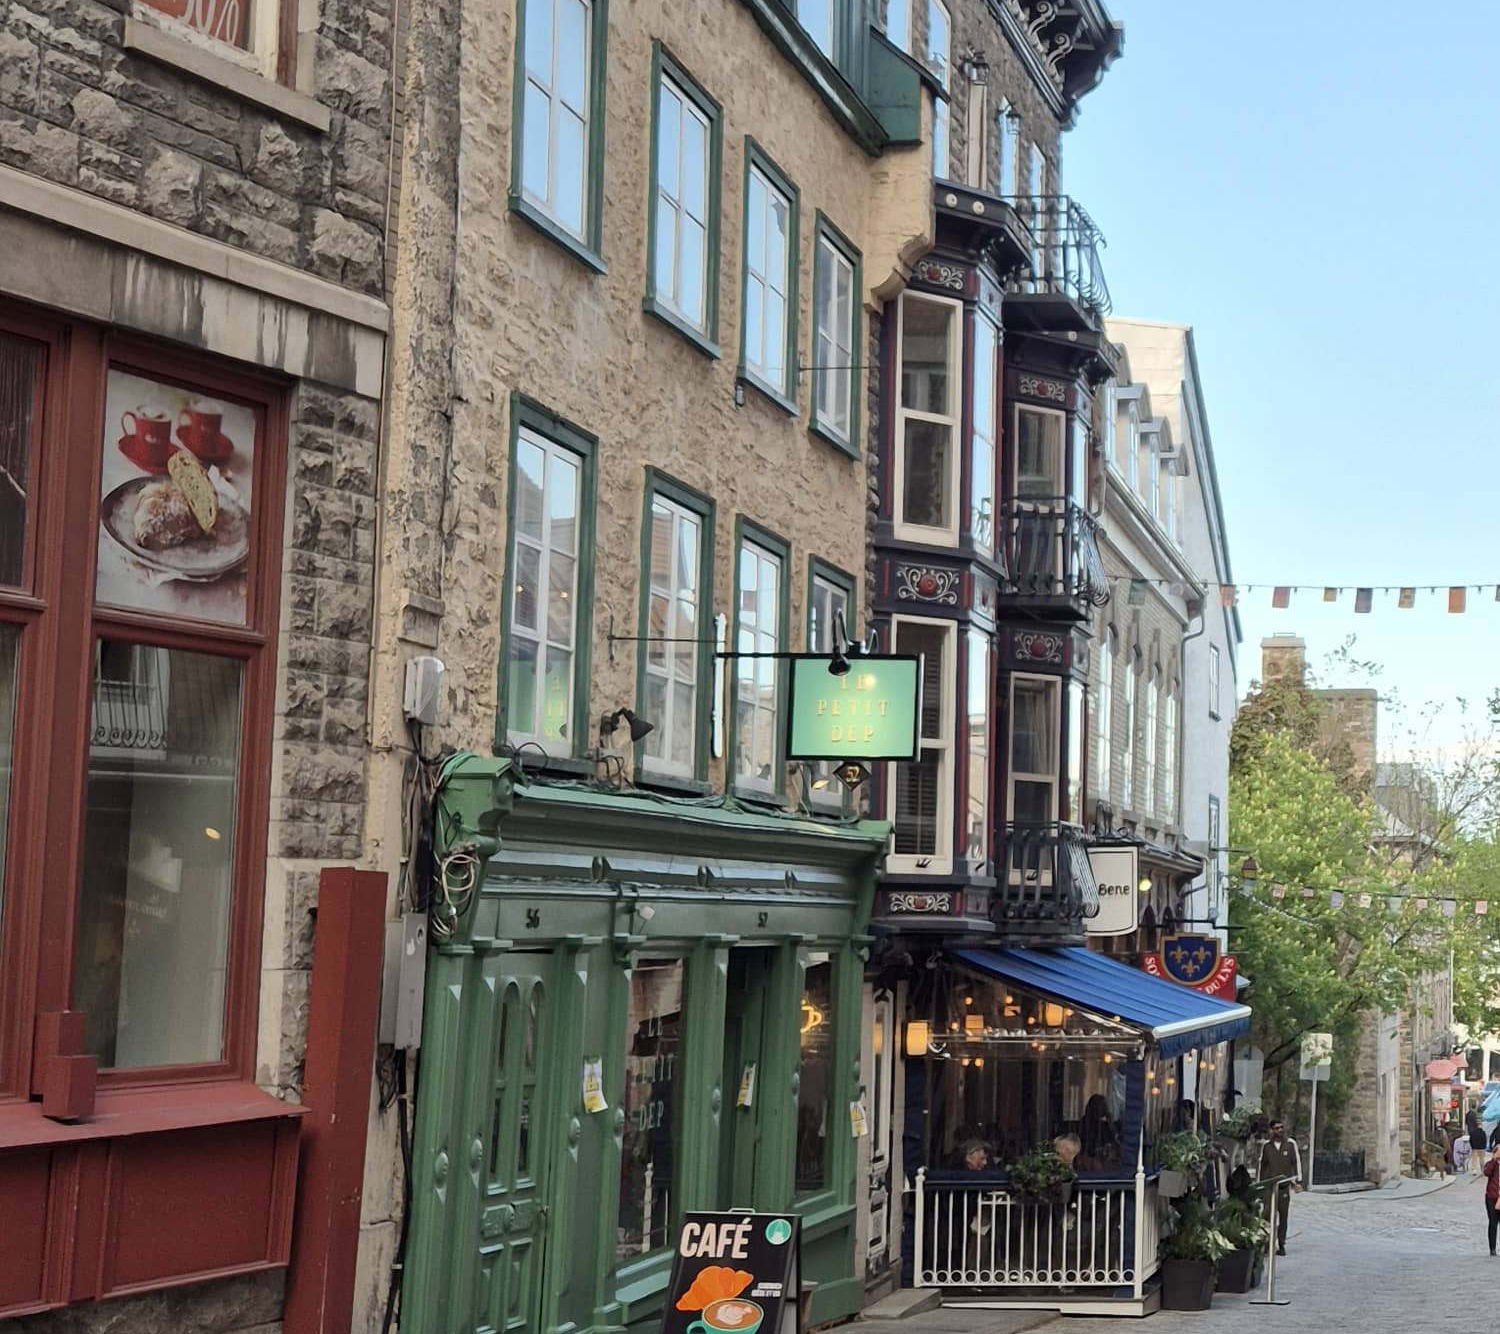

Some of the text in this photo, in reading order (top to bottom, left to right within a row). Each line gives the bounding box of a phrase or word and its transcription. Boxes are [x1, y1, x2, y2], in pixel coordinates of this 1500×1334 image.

[816, 699, 889, 716] PETIT
[1097, 883, 1131, 896] Bene
[1204, 957, 1235, 995] DU LYS
[639, 1100, 665, 1132] DEP
[680, 1218, 753, 1259] CAFÉ
